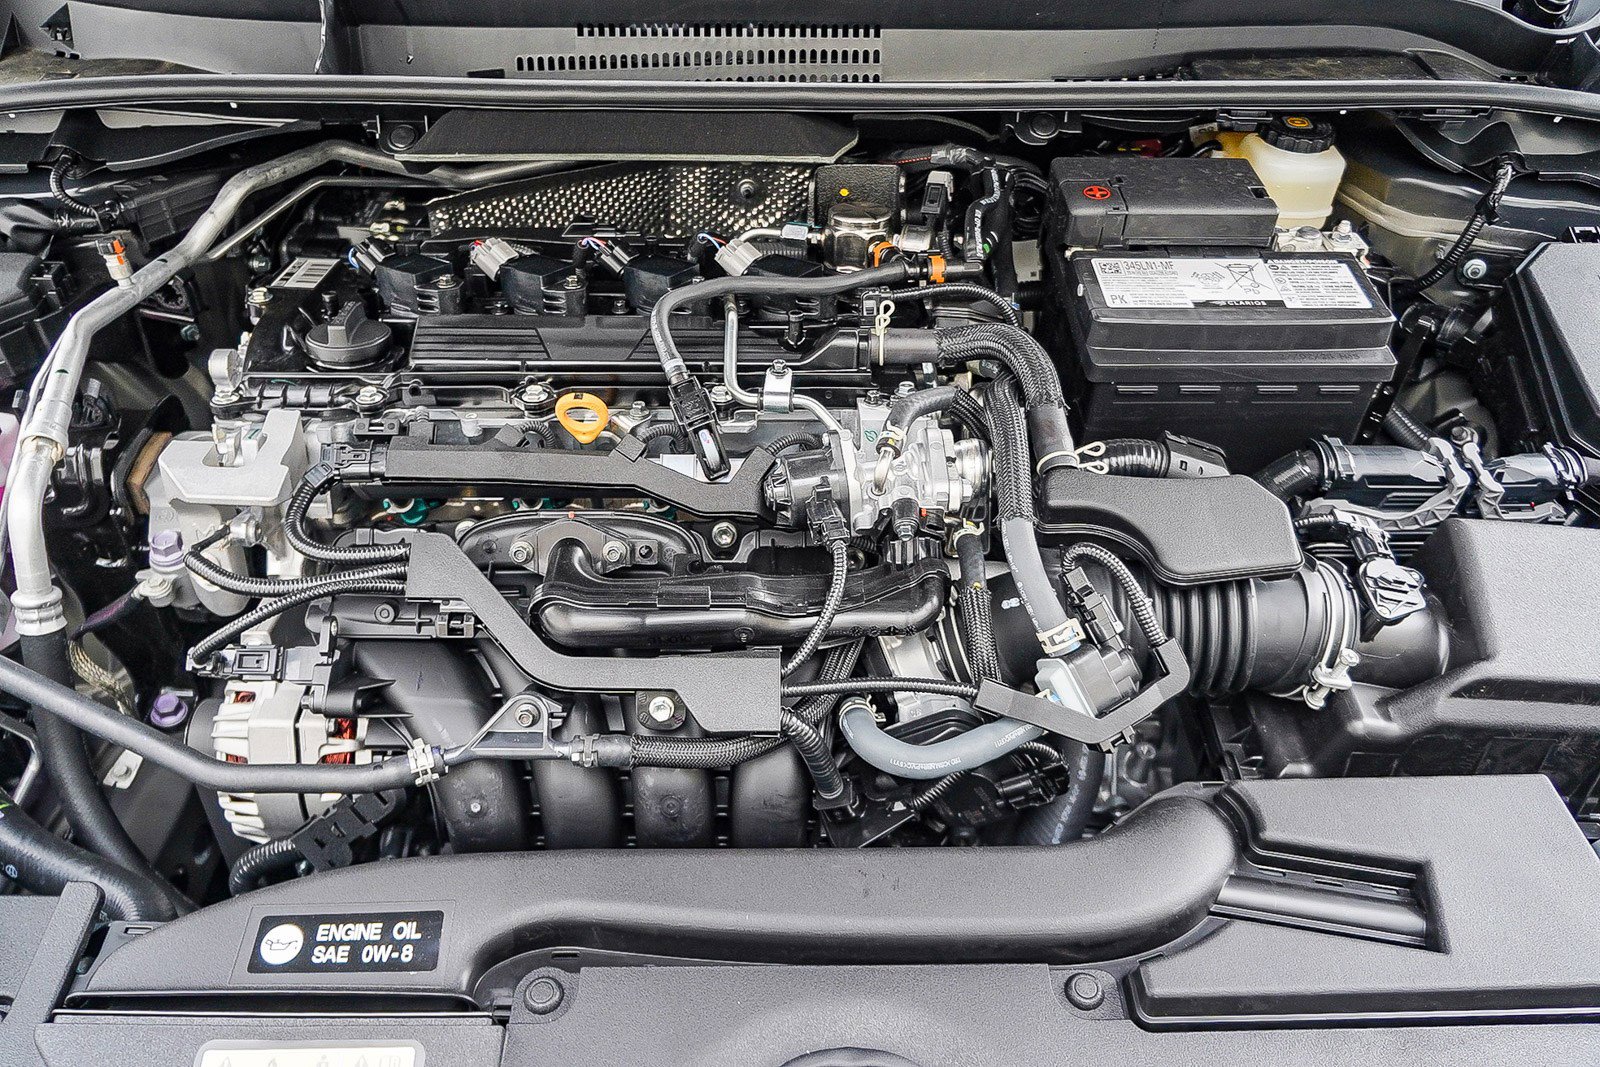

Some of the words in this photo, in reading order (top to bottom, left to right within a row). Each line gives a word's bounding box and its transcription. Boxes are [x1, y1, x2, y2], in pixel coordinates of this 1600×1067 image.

[1124, 261, 1174, 271] 345LN1-MF
[1243, 287, 1260, 295] Pb
[1110, 294, 1128, 304] PK
[316, 922, 383, 942] ENGINE
[392, 921, 422, 941] OIL
[311, 944, 350, 964] SAE
[361, 944, 414, 964] 0W-8
